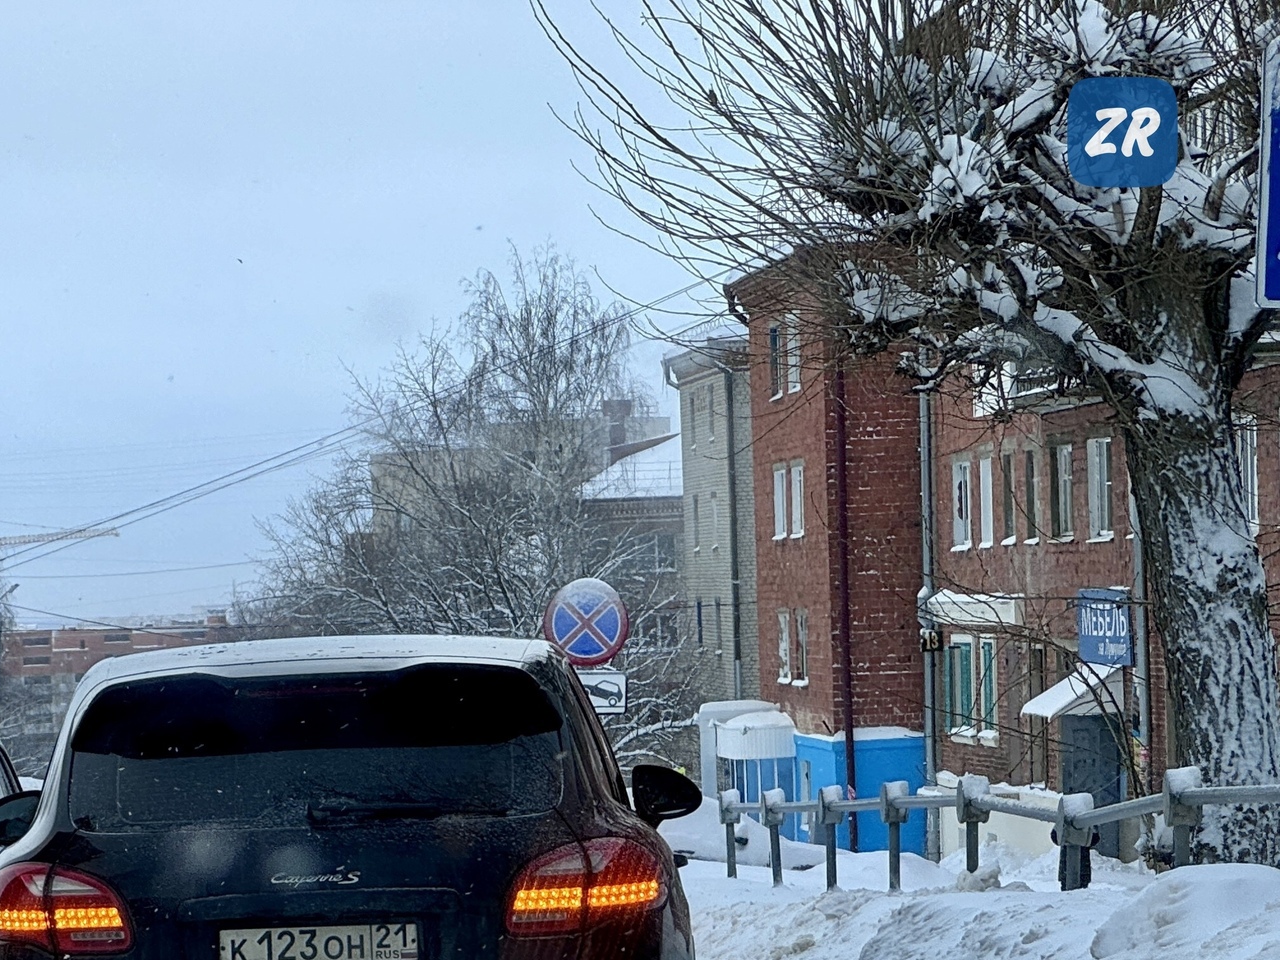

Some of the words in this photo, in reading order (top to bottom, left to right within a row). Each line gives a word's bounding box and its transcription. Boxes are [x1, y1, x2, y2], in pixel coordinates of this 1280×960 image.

[1081, 601, 1127, 637] МЕБЕЛЬ
[924, 631, 939, 650] 13
[271, 872, 342, 888] Cayenne
[375, 924, 407, 949] 21
[375, 949, 400, 959] RUS
